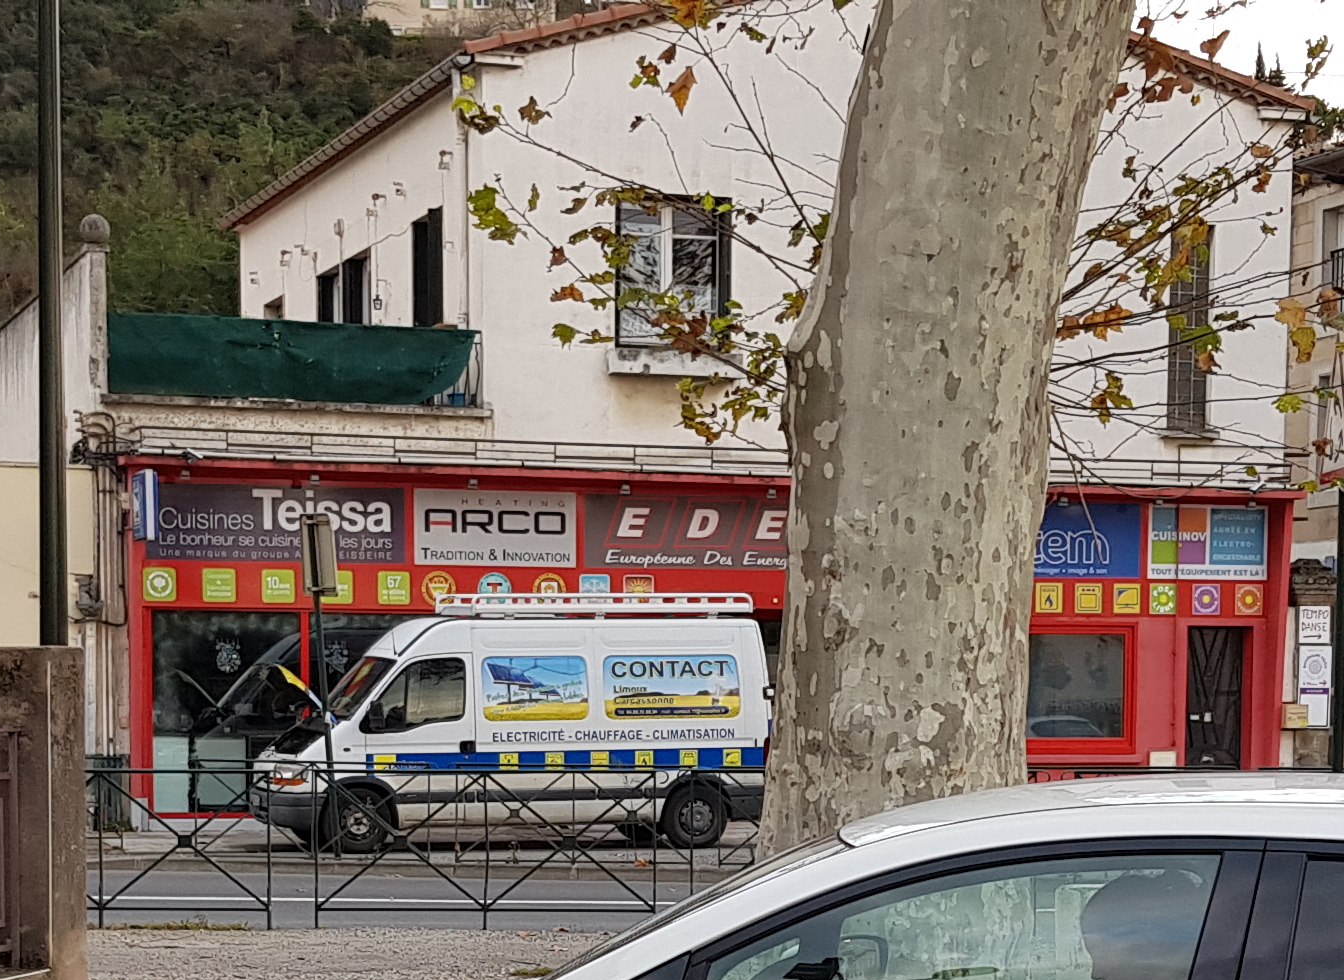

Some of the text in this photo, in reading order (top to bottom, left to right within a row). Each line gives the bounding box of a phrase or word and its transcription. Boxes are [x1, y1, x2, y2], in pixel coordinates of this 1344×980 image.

[158, 488, 392, 533] Cuisines Teissa
[424, 508, 566, 535] ARCO
[158, 532, 176, 546] Le
[180, 532, 235, 547] bonheur
[239, 535, 255, 547] se
[339, 535, 359, 549] les
[360, 535, 393, 551] jours
[159, 549, 181, 559] Une
[186, 550, 227, 561] marque
[233, 550, 246, 559] du
[251, 550, 290, 561] groupe
[339, 551, 393, 561] EISSEIRE
[421, 547, 571, 563] TRADITION & INNOVATION
[605, 549, 788, 570] Européenne Des Energ
[1151, 568, 1172, 576] TOUT
[266, 576, 279, 589] 10
[387, 576, 402, 588] 67
[1301, 608, 1329, 620] TEMPO
[1301, 622, 1328, 632] DANSE
[611, 660, 729, 678] CONTACT
[492, 729, 565, 742] ELECTRICITÉ
[574, 729, 643, 741] CHAUFFAGE
[652, 728, 735, 740] CLIMATISATION
